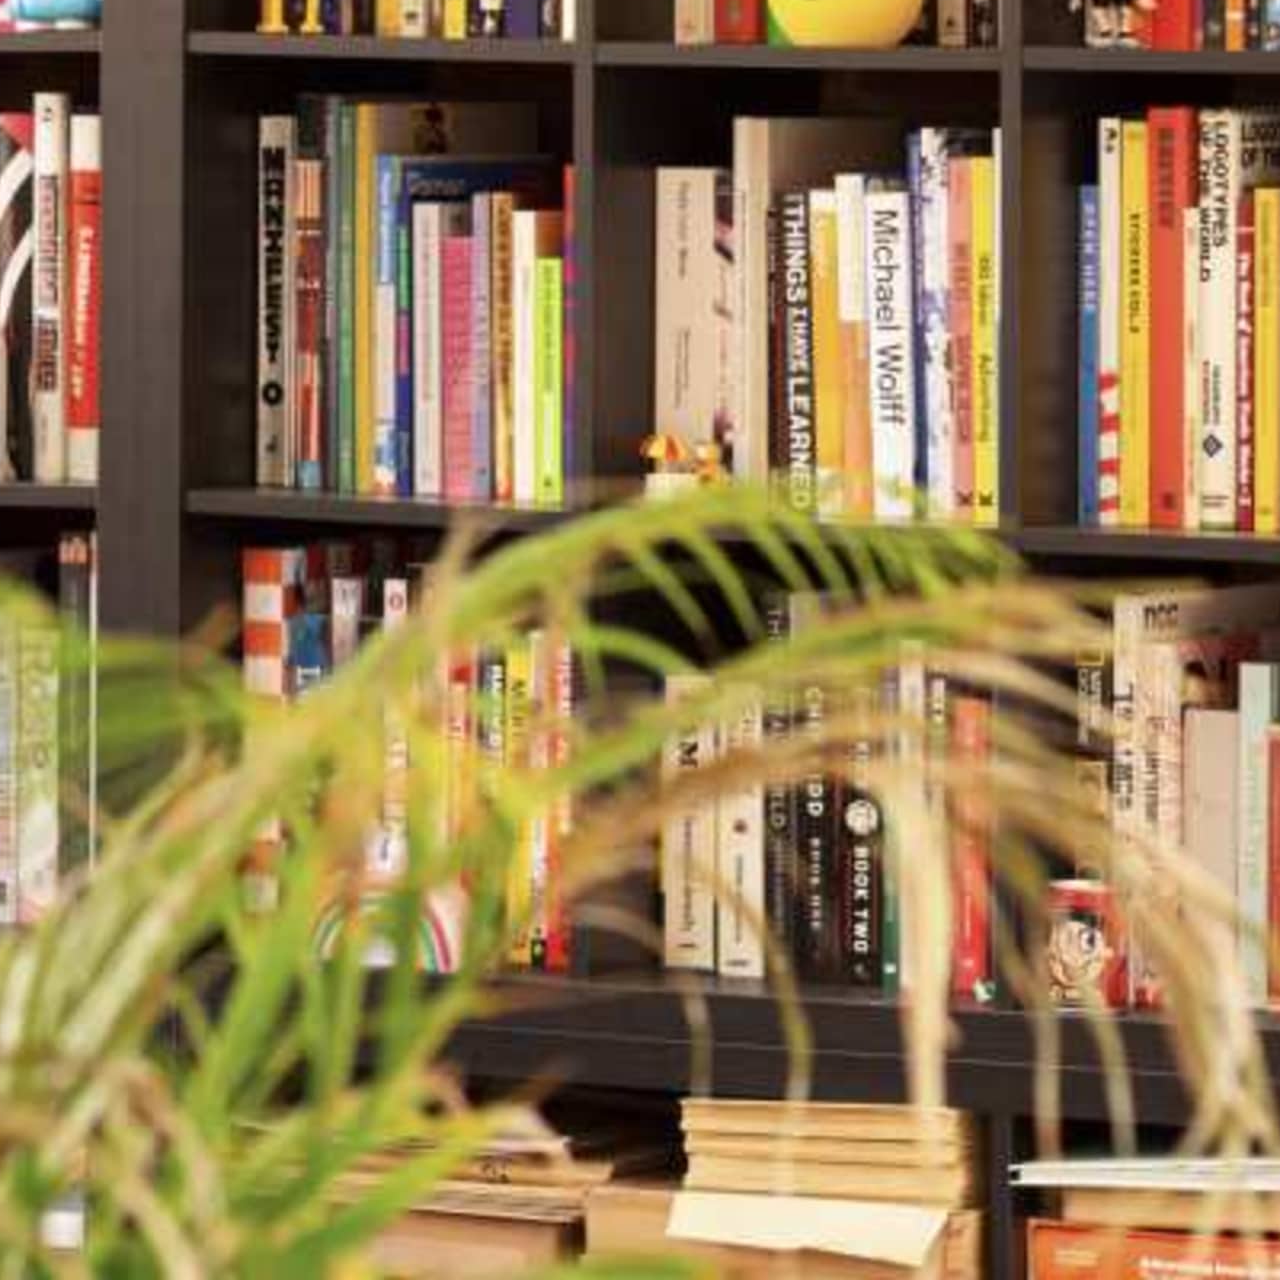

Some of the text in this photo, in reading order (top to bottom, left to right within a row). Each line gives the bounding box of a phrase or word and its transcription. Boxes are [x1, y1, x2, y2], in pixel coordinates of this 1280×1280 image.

[784, 205, 807, 302] THINGS
[874, 209, 907, 424] Michael Wolff
[853, 845, 869, 901] BOOK
[853, 908, 869, 954] TWO
